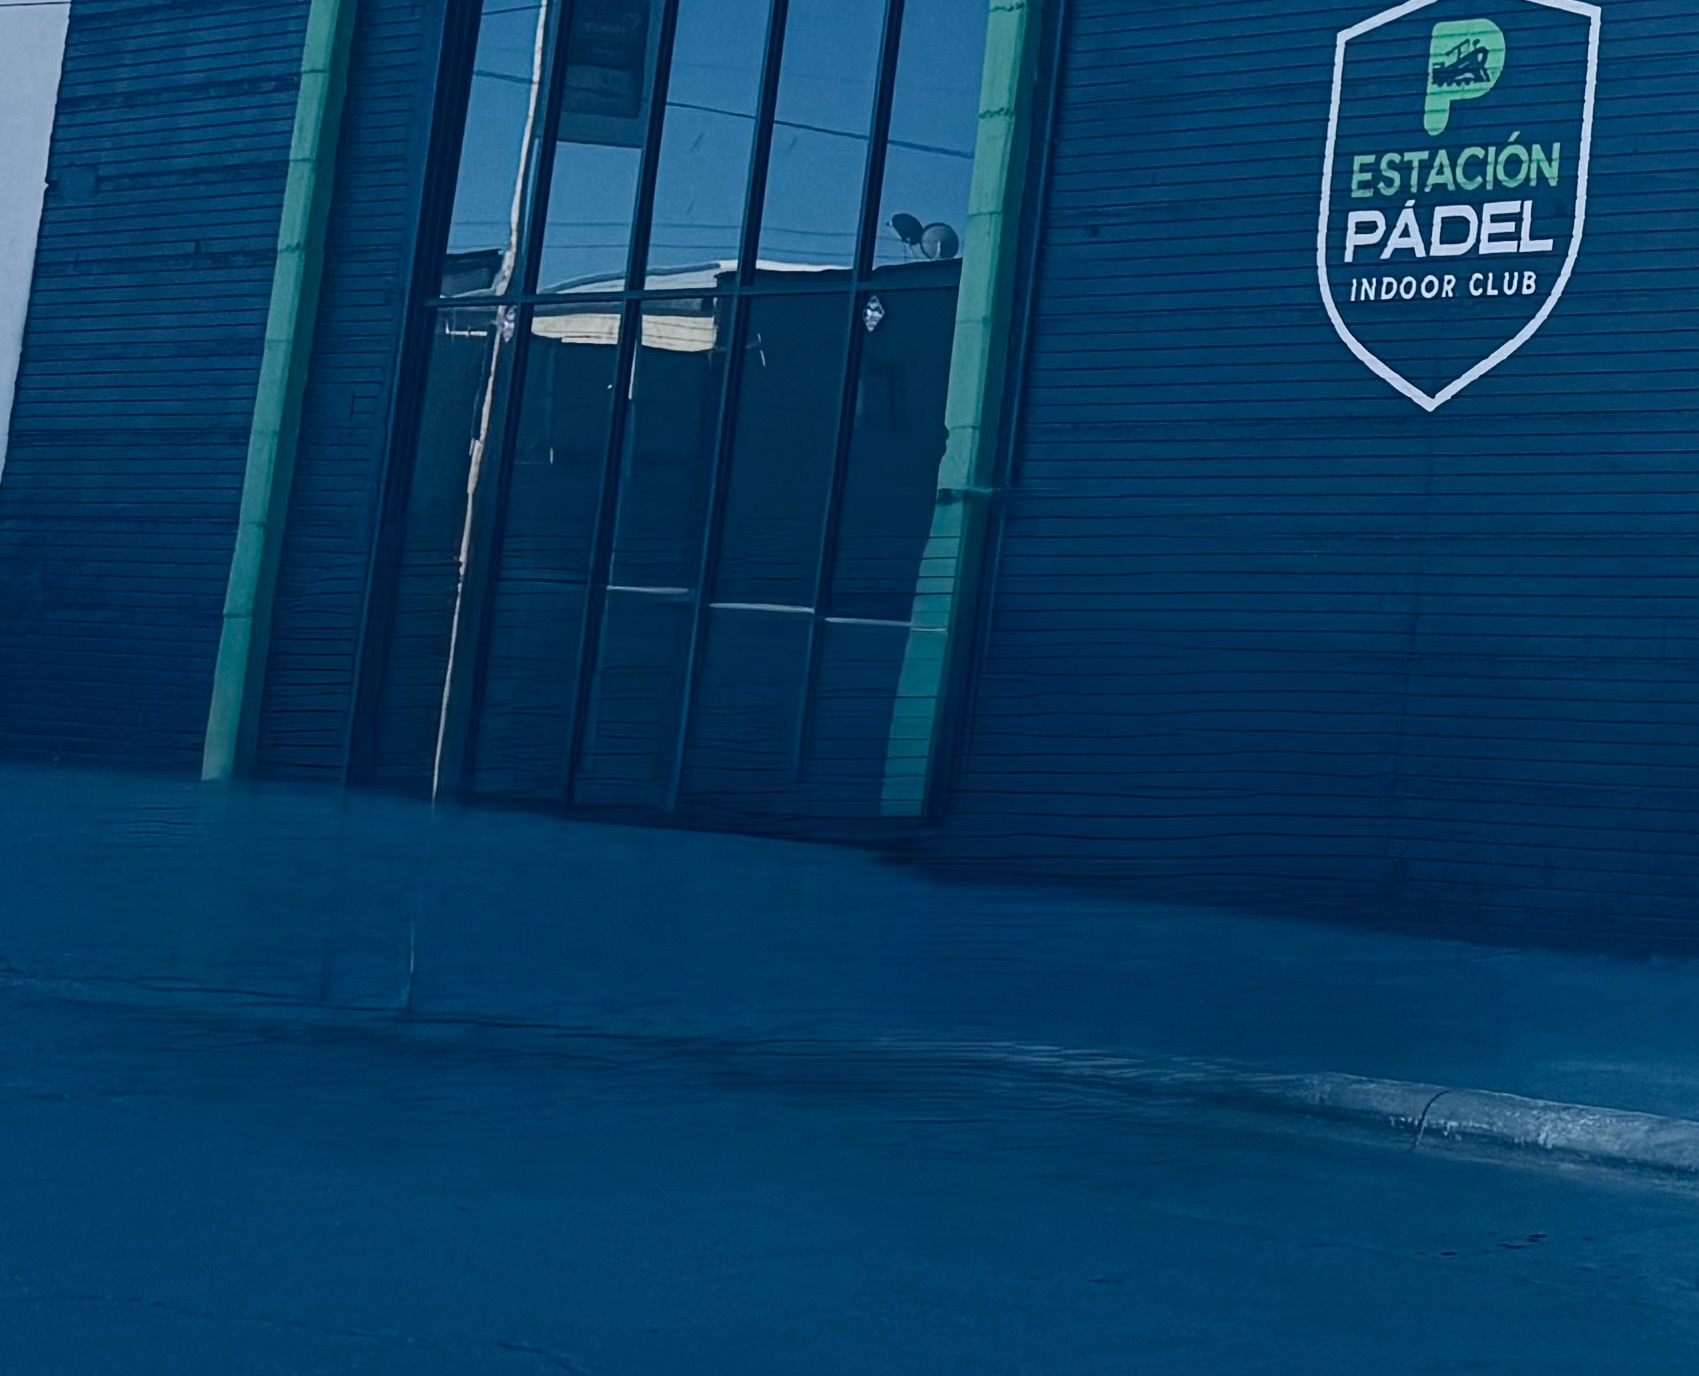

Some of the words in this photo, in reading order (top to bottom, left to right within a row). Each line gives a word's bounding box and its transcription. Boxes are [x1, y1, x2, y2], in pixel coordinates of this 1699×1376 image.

[1350, 131, 1561, 198] ESTACIÓN
[1344, 199, 1553, 263] PÁDEL
[1350, 274, 1455, 301] INDOOR
[1468, 271, 1537, 297] CLUB
